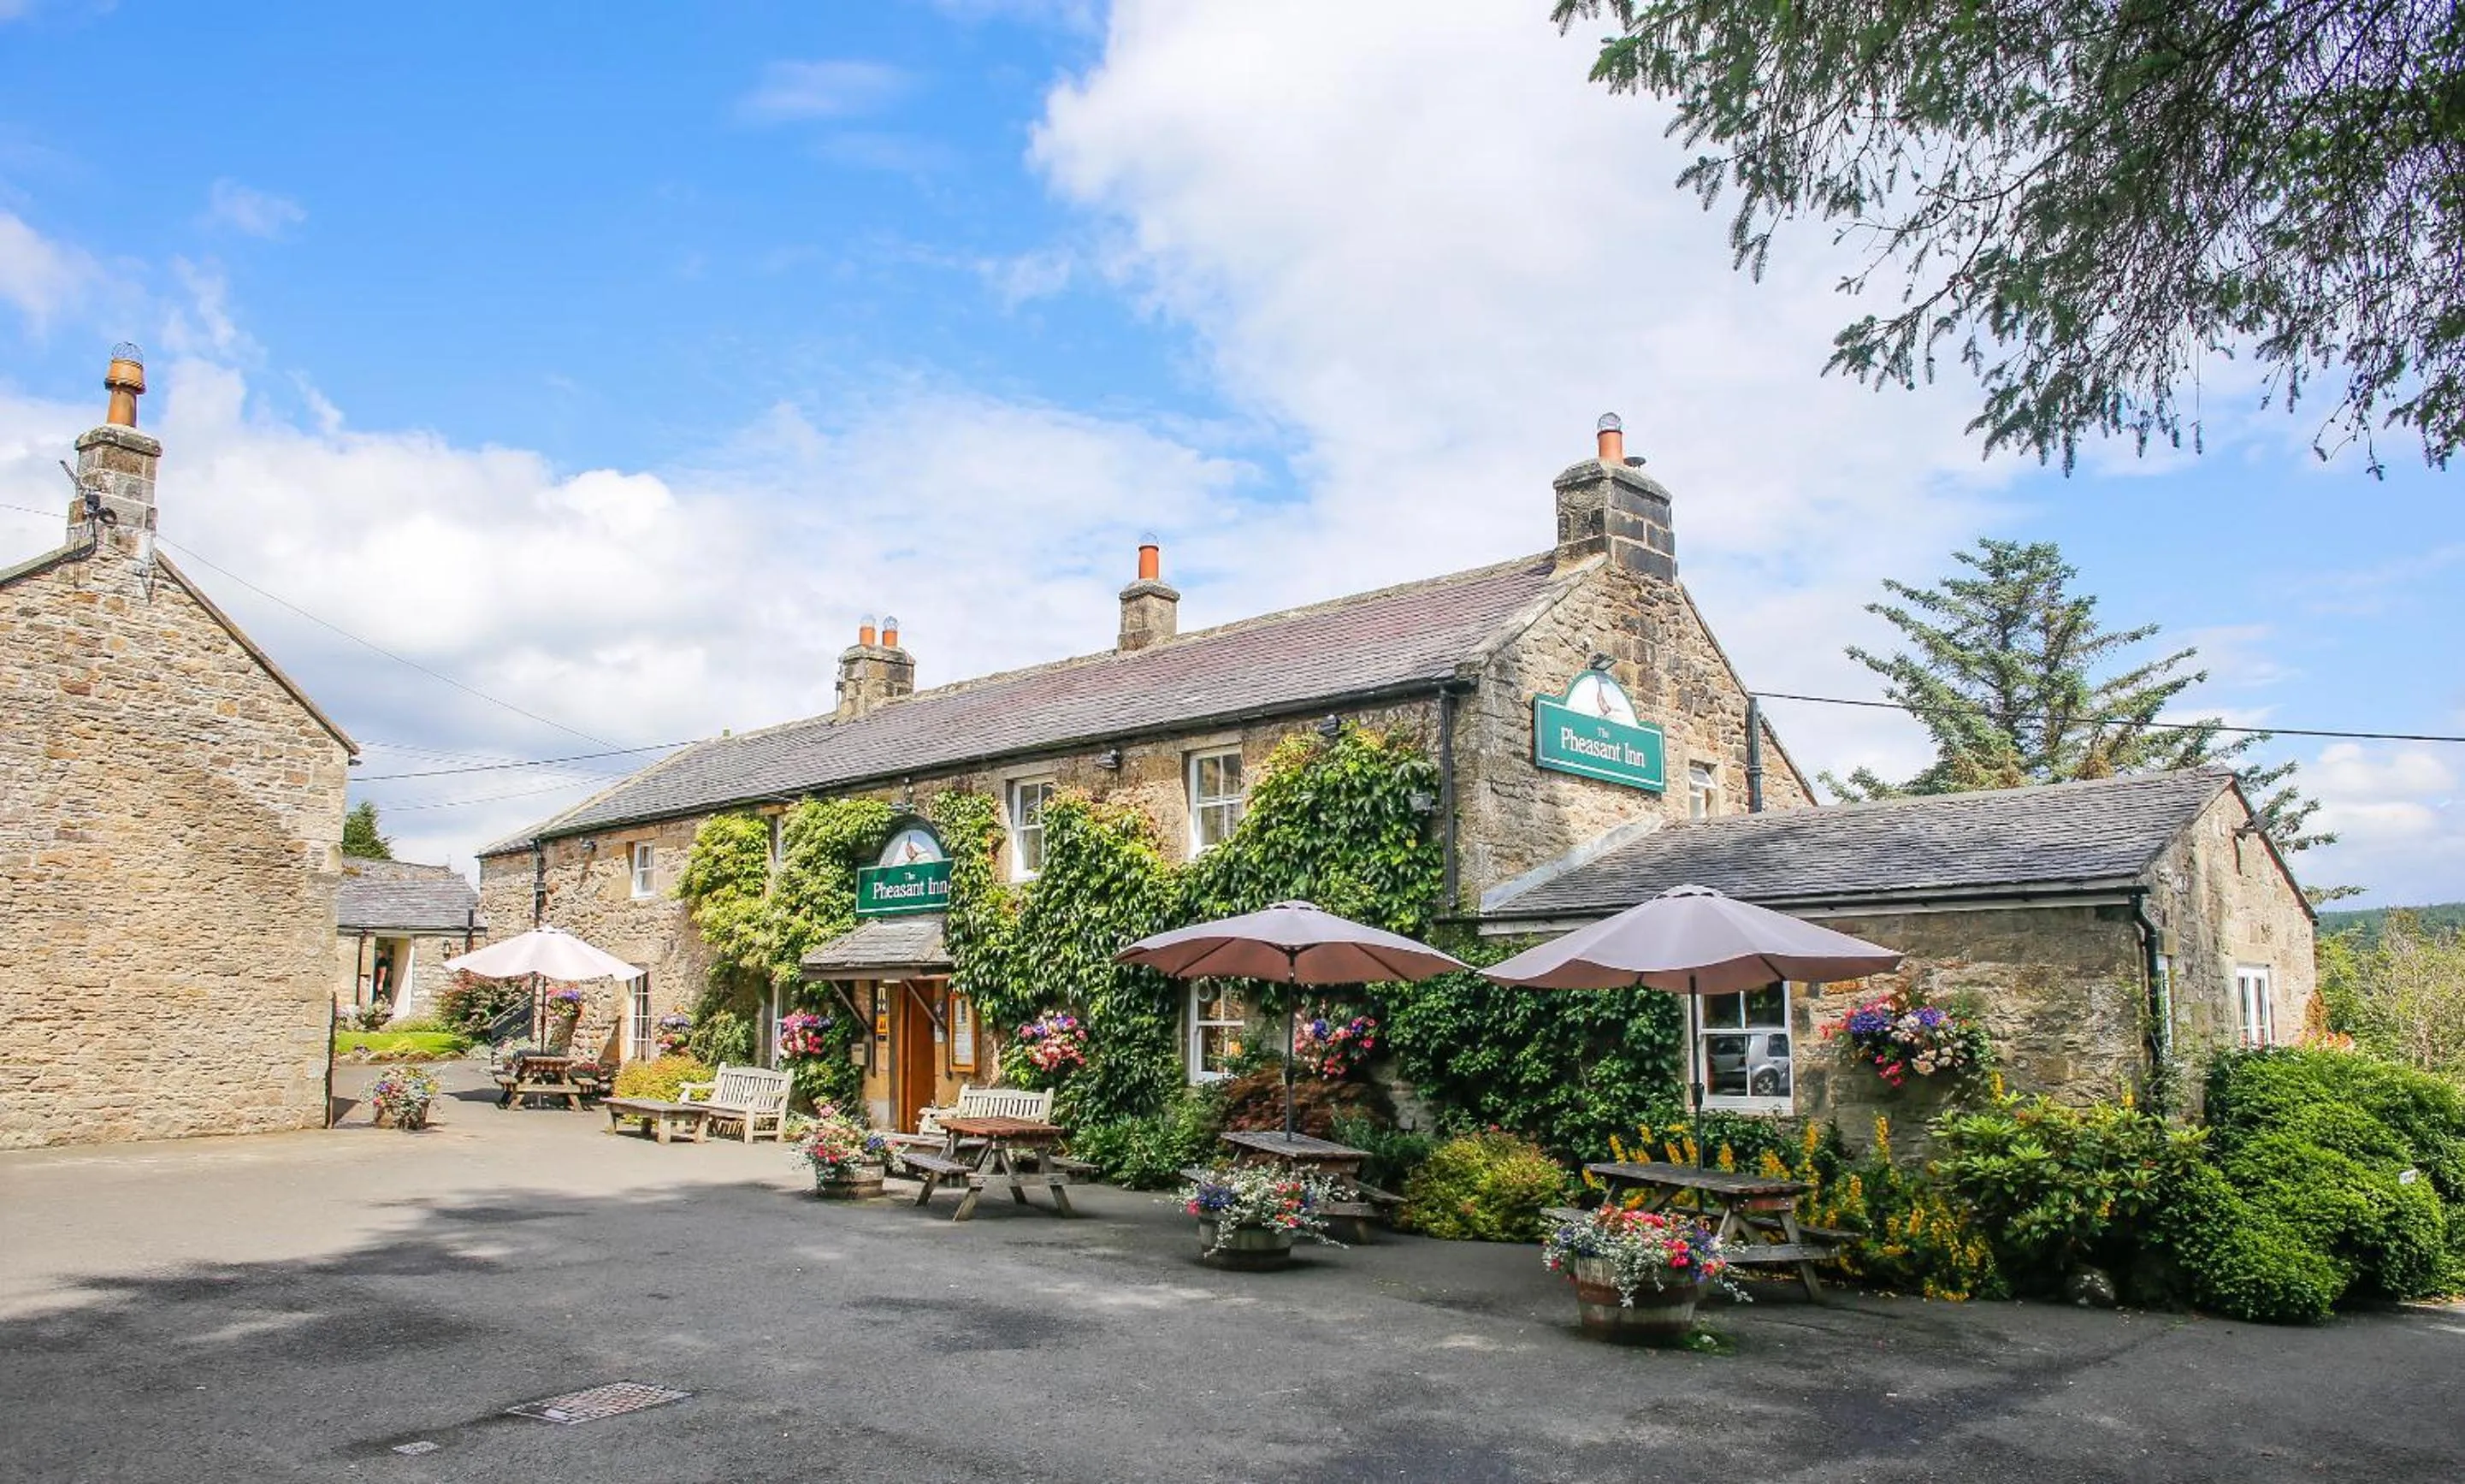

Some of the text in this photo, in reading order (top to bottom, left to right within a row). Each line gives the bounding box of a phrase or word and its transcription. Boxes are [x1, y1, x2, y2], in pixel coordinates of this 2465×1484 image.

[1598, 726, 1609, 738] The
[1561, 727, 1646, 767] Pheasant Inn
[905, 872, 916, 881] The
[872, 877, 948, 900] Pheasant Inn
